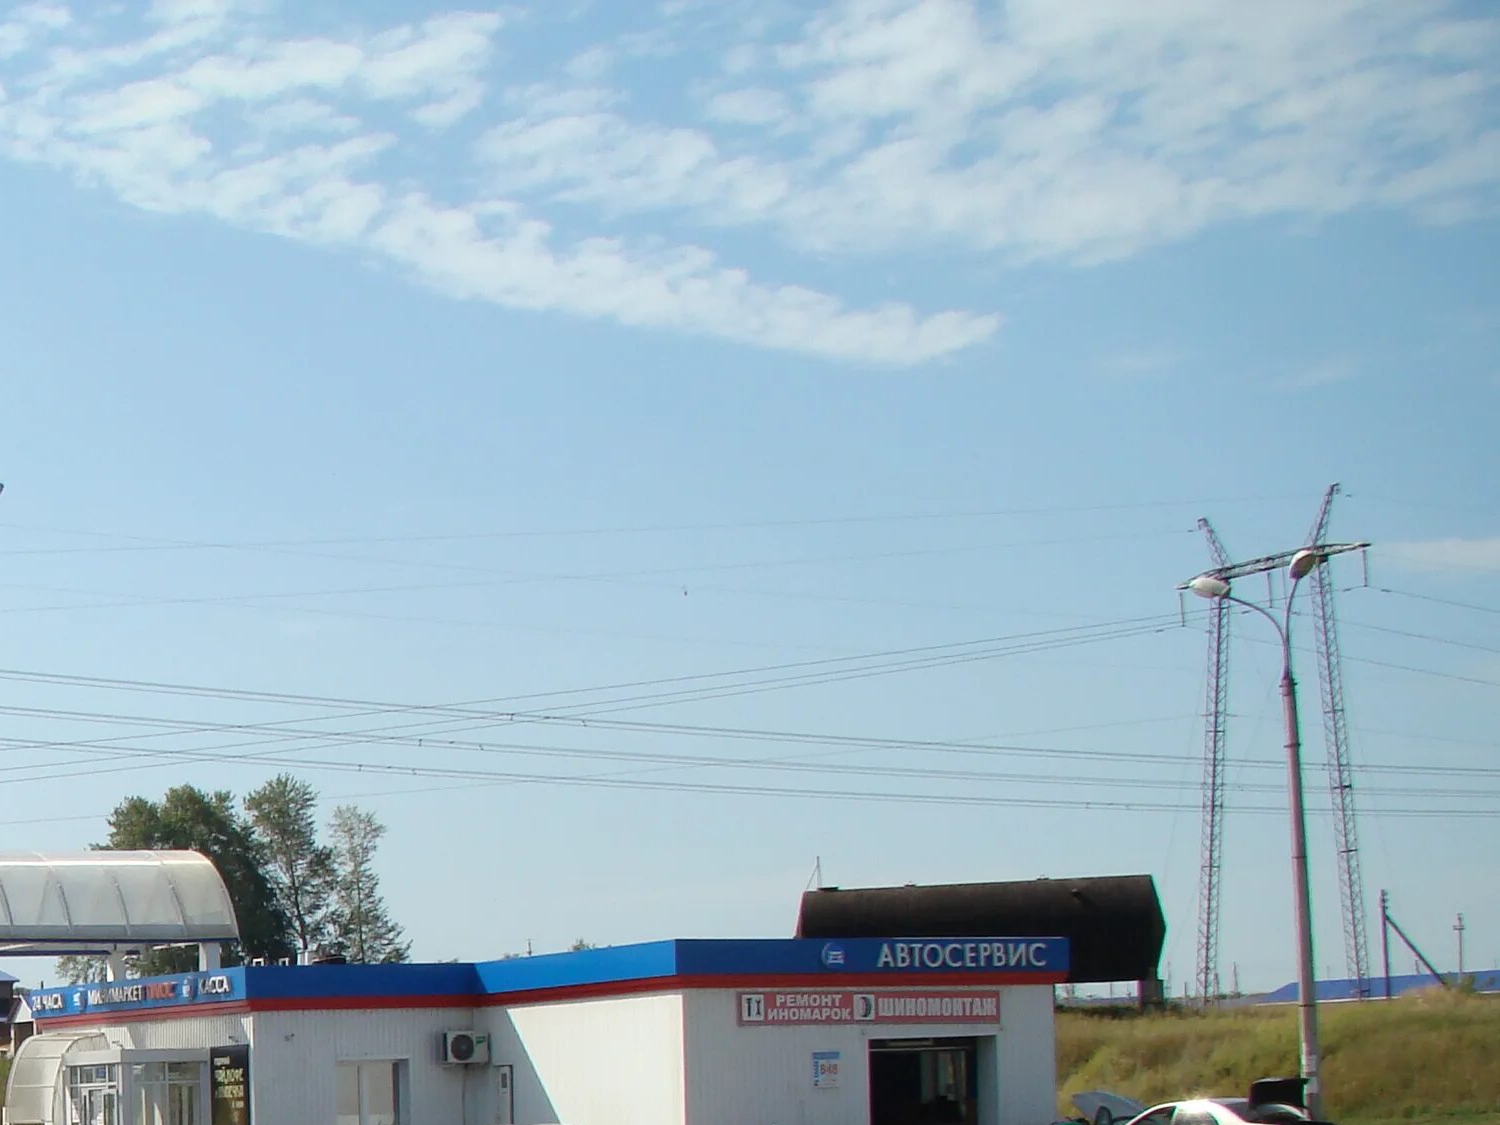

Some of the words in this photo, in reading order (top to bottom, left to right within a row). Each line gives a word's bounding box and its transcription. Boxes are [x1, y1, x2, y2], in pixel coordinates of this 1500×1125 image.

[877, 942, 1047, 968] АВТОСЕРВИС
[198, 976, 230, 995] КАССА
[775, 993, 842, 1007] РЕМОНТ
[878, 997, 997, 1017] ШИНОМОНТАЖ
[767, 1007, 851, 1021] ИНОМАРОК
